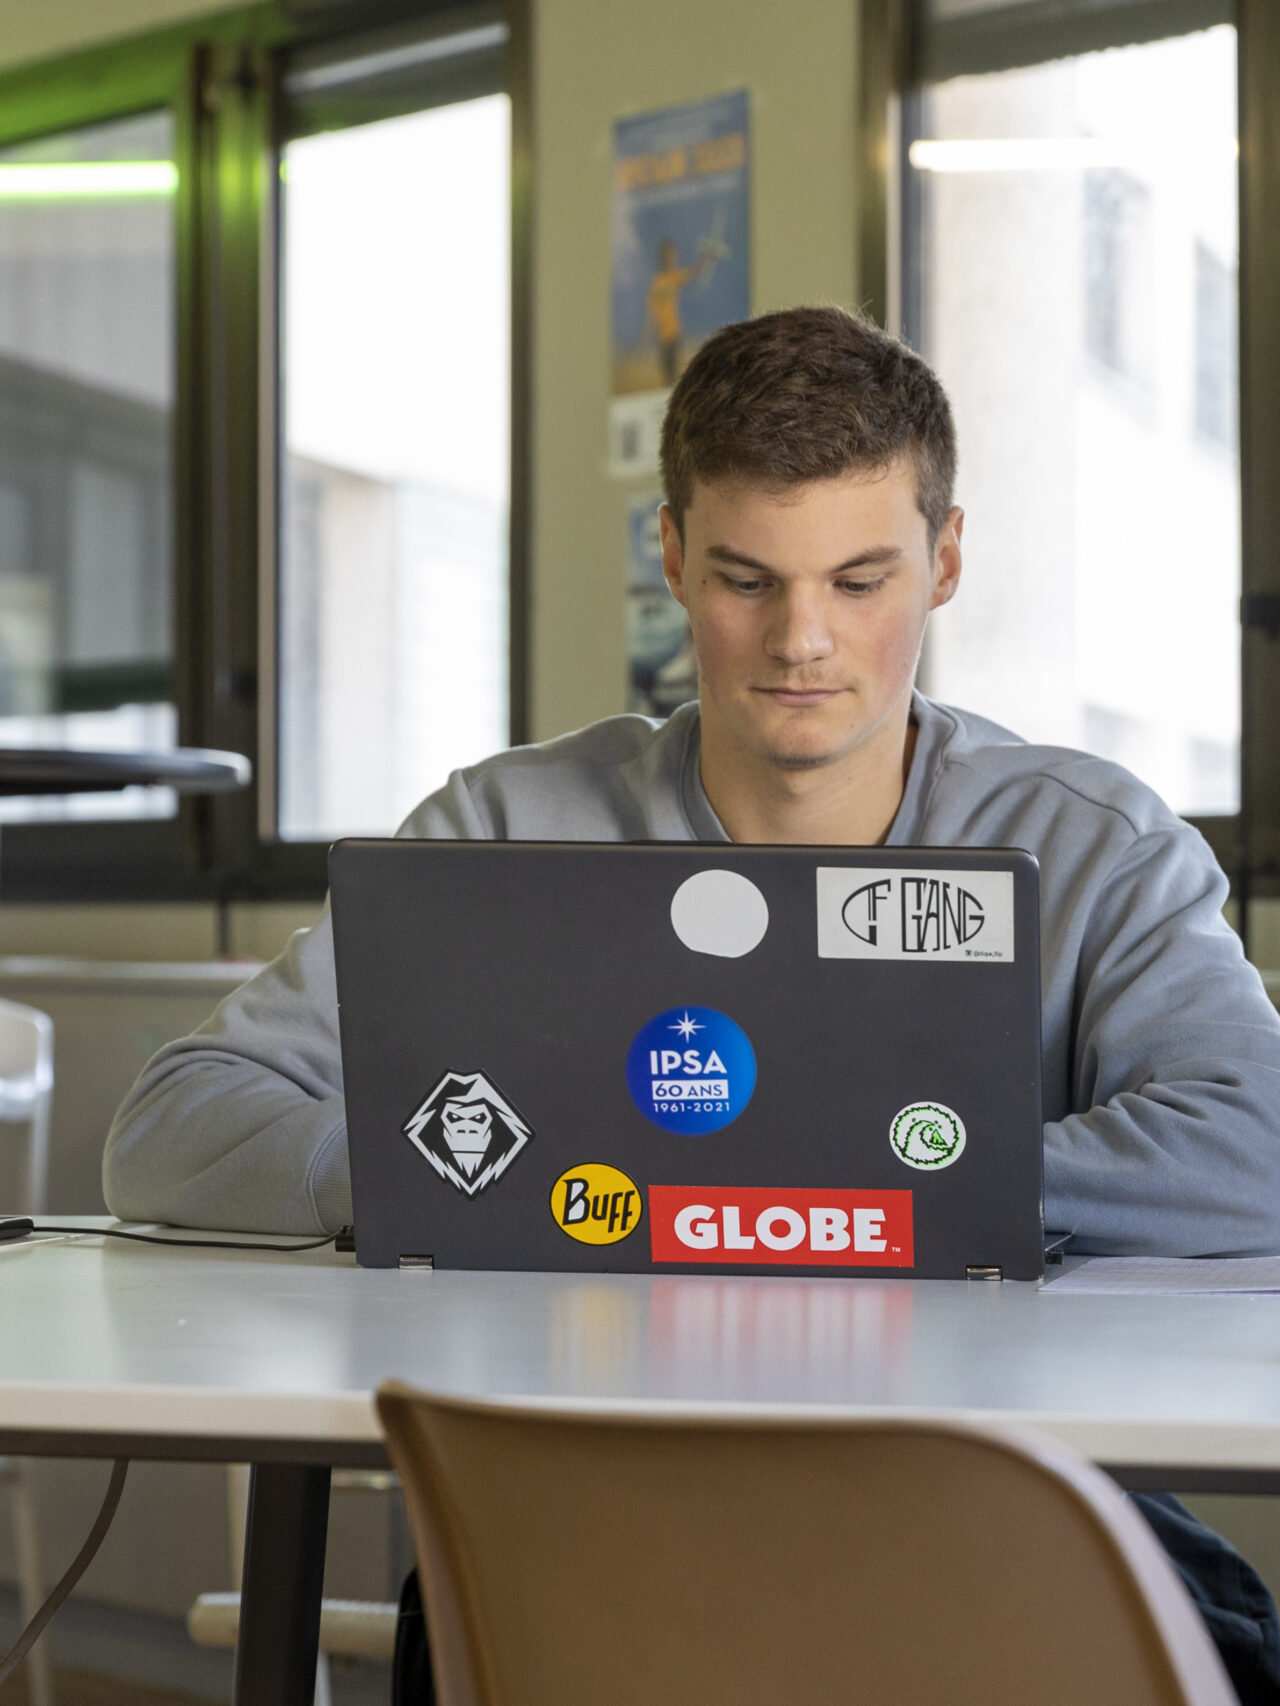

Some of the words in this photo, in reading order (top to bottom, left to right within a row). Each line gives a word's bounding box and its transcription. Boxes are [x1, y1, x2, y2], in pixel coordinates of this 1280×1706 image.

[900, 876, 986, 953] GANG
[650, 1049, 728, 1075] IPSA
[655, 1083, 683, 1098] 60
[687, 1084, 723, 1097] ANS
[653, 1102, 730, 1112] 1961-2021
[674, 1204, 887, 1252] GLOBE
